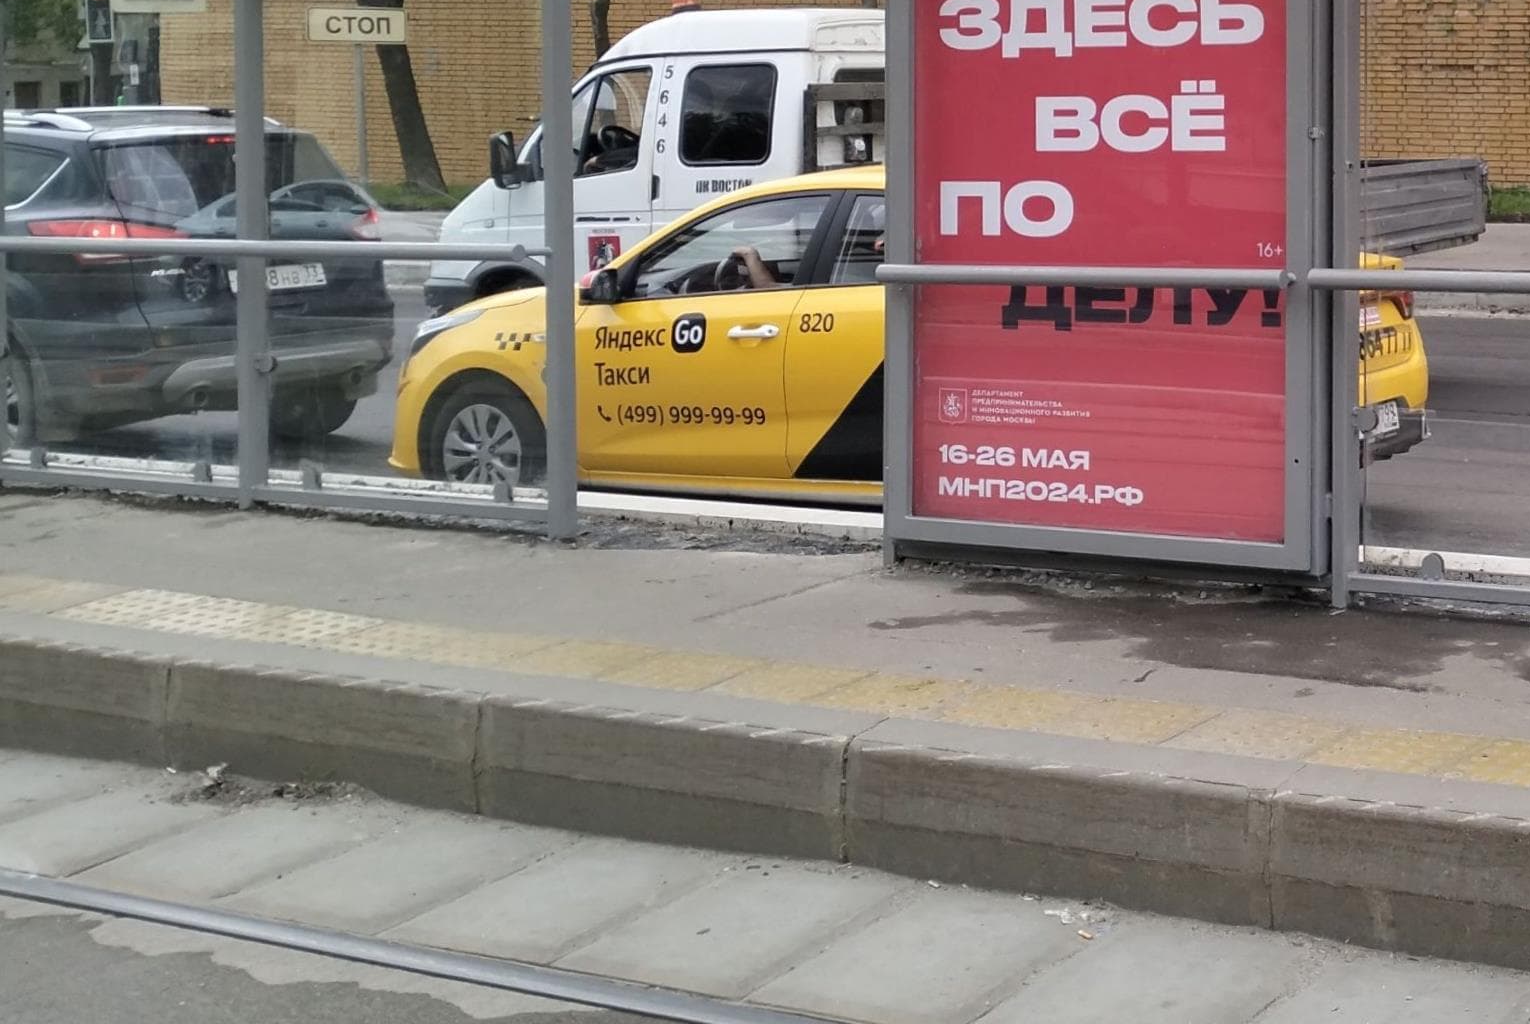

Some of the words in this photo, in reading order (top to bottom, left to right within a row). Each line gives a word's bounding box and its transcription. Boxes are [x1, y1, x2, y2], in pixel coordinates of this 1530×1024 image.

[325, 16, 391, 35] СТОП
[1035, 79, 1226, 152] ВСЁ
[940, 180, 1075, 237] ПО
[1256, 242, 1284, 258] 16+
[799, 312, 834, 333] 820
[1001, 287, 1282, 332] ДЕЛУ!
[594, 326, 666, 351] Яндекс
[674, 319, 703, 345] Go
[594, 362, 650, 386] Такси
[617, 404, 664, 426] (499)
[669, 406, 766, 425] 999-99-99
[938, 444, 1016, 467] 16-26
[1022, 448, 1090, 470] МАЯ
[938, 476, 1143, 506] МНП2024.РФ
